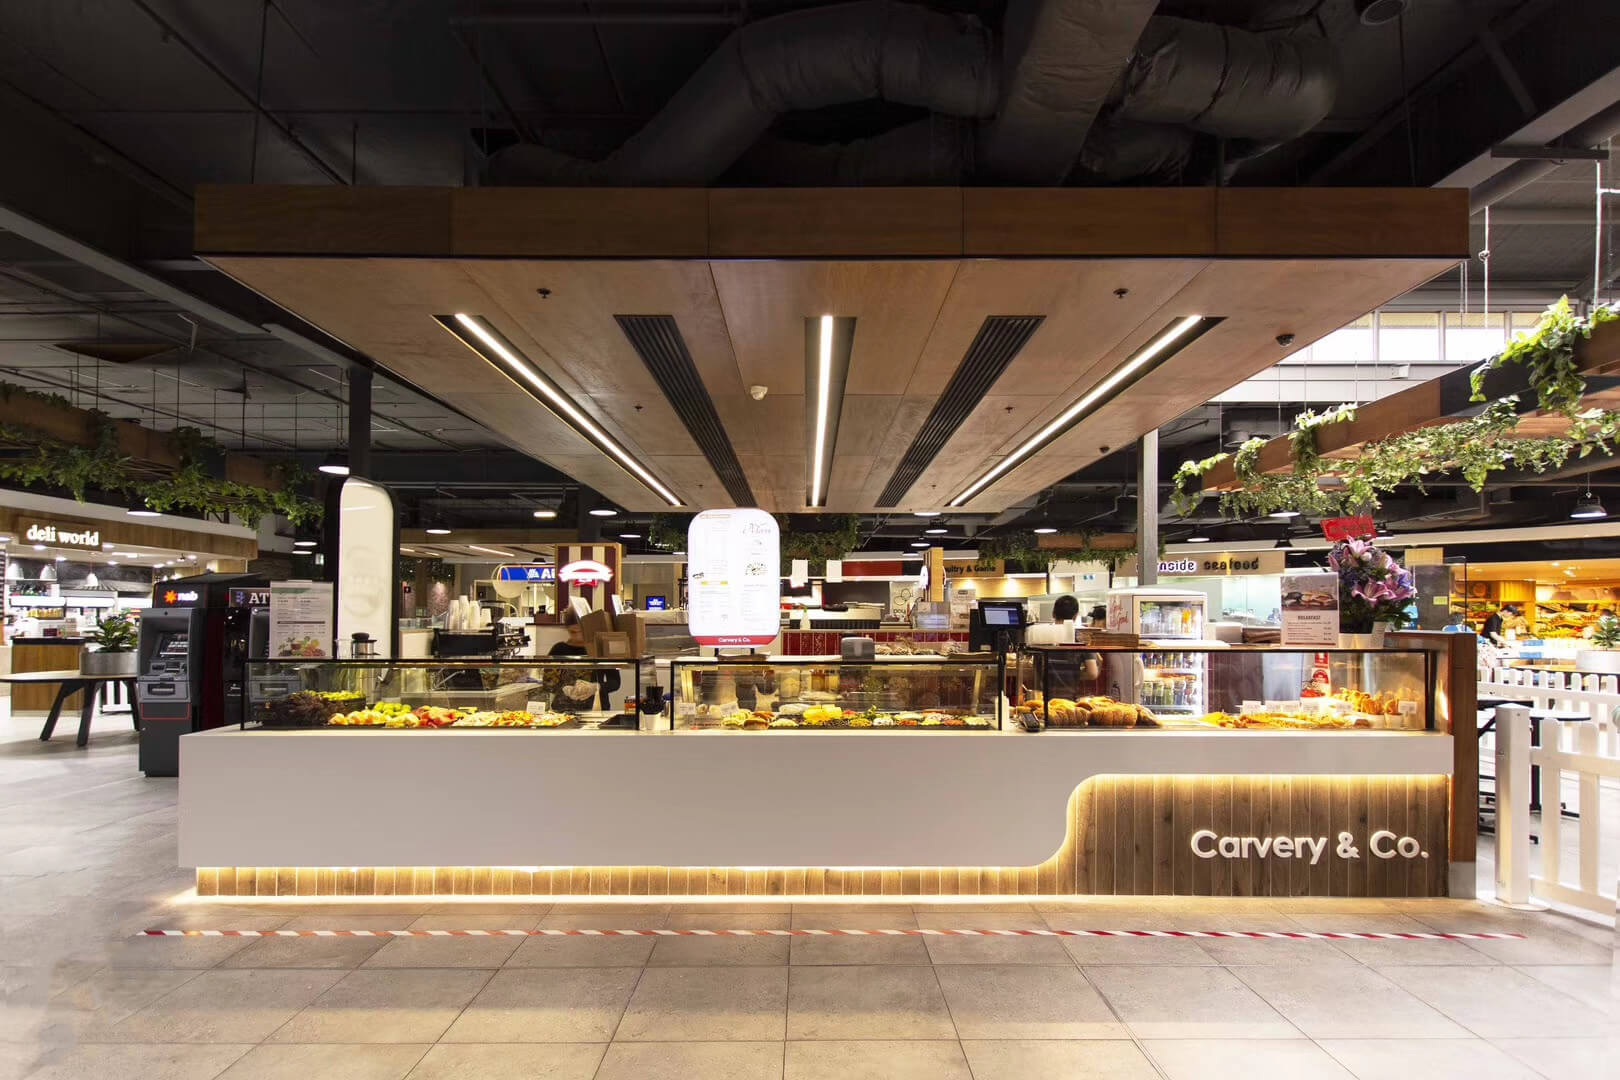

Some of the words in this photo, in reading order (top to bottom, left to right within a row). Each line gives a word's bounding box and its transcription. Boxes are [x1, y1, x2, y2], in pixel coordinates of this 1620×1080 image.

[26, 524, 56, 542] deli
[58, 530, 99, 546] world
[178, 591, 198, 601] nab
[1190, 829, 1328, 865] Carvery
[1336, 831, 1360, 859] &
[1369, 830, 1430, 859] Co.
